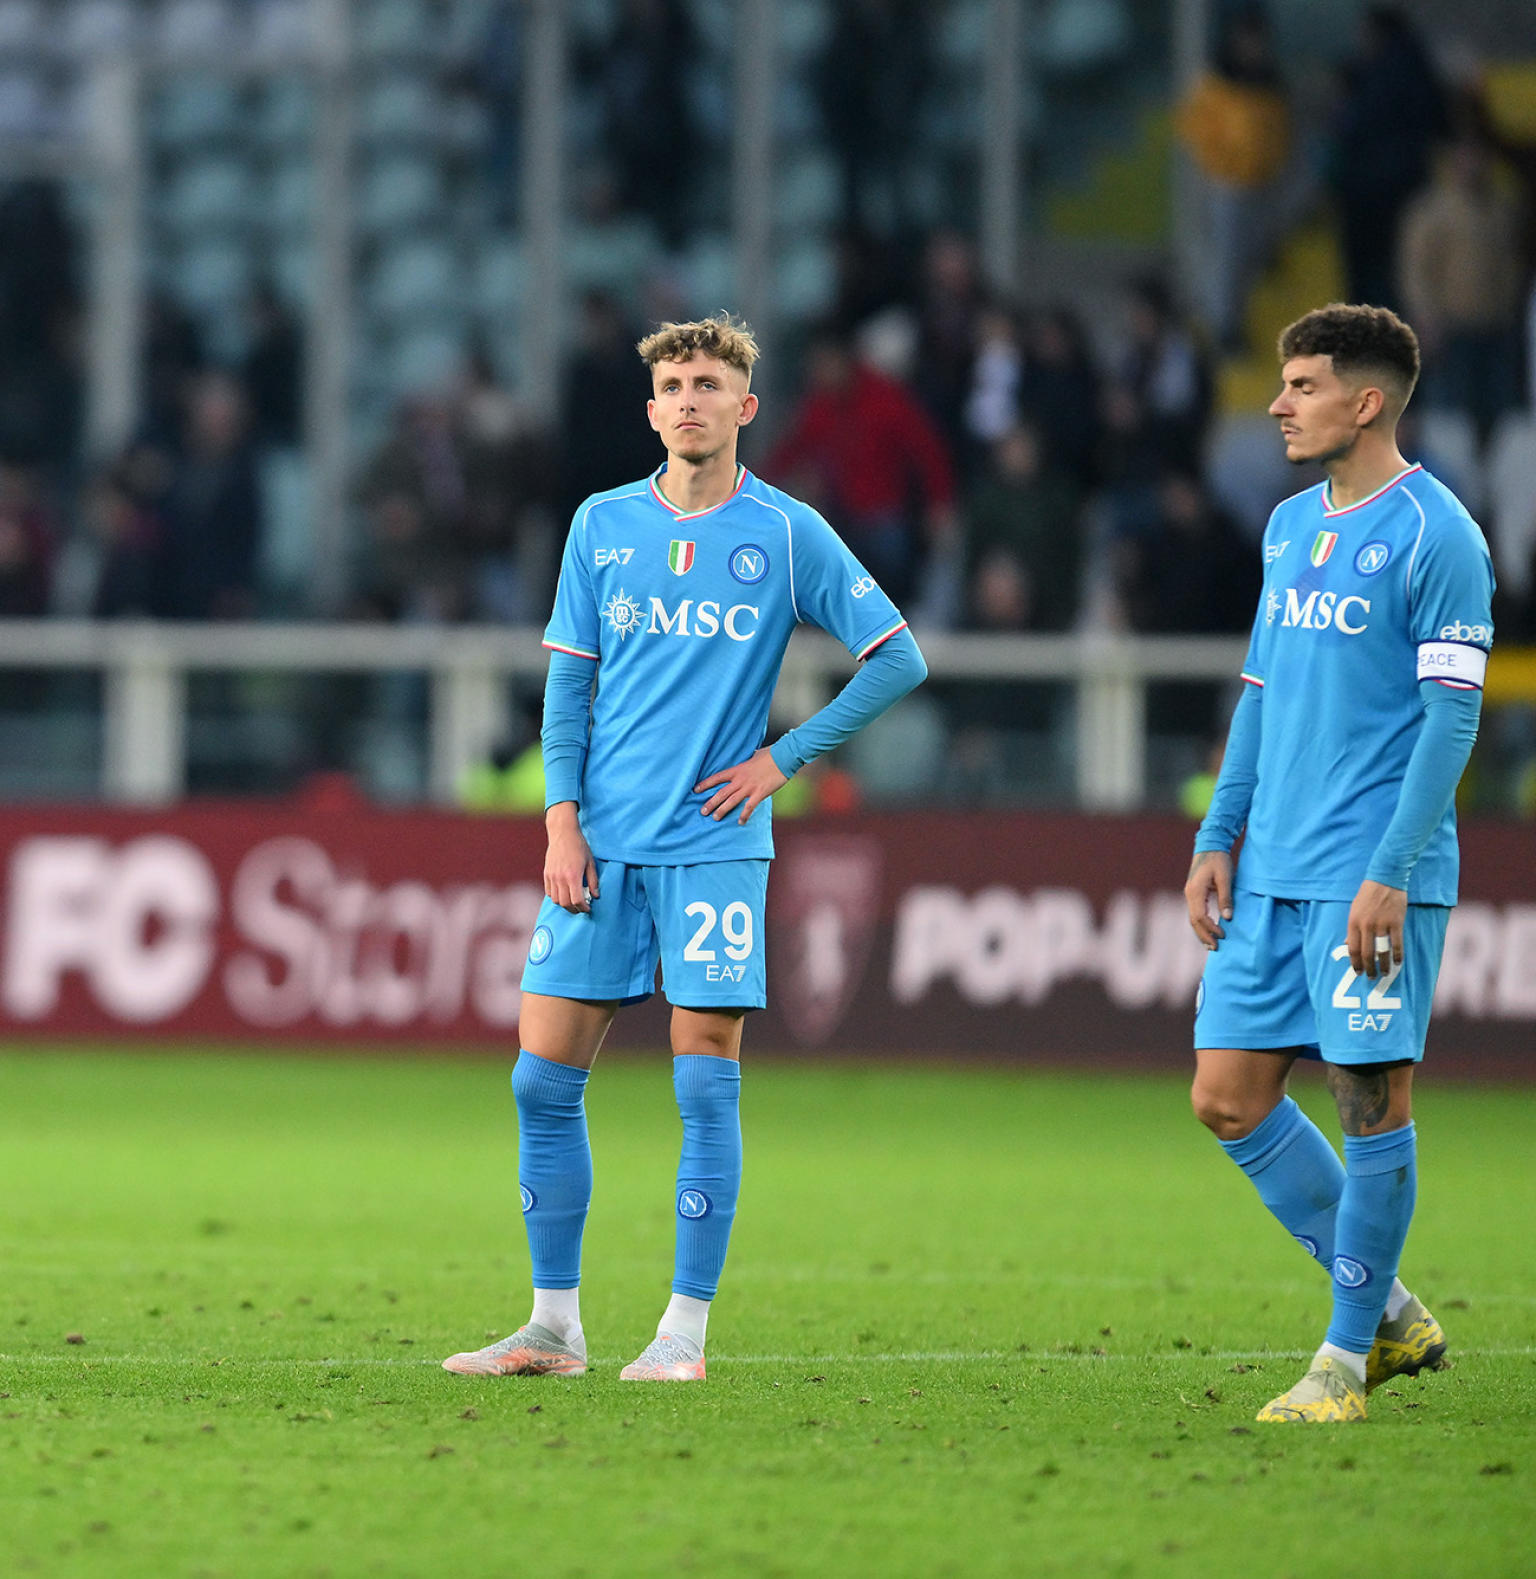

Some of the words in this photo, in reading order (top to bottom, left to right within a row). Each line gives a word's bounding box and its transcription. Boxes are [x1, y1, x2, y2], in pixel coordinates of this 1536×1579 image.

[594, 548, 635, 566] EA7
[646, 596, 759, 642] MSC
[1281, 588, 1371, 635] MSC
[1440, 619, 1491, 647] ebay
[0, 833, 220, 1026] FC
[683, 901, 753, 961] 29
[705, 965, 747, 983] EA7
[1331, 943, 1402, 1010] 22
[1348, 1013, 1393, 1032] EA7
